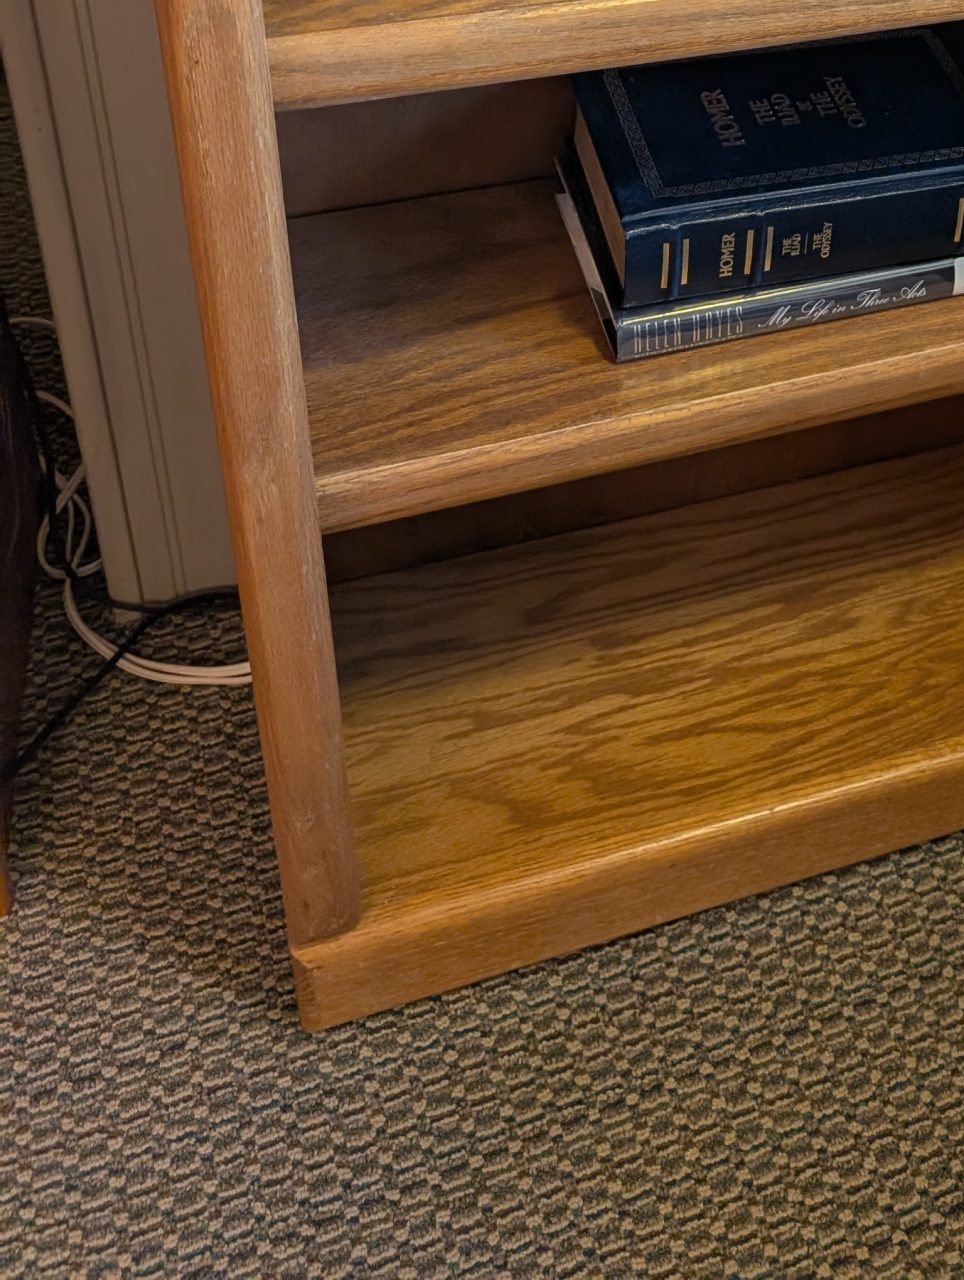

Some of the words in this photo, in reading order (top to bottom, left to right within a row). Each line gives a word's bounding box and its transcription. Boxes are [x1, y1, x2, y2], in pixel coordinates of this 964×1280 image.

[701, 89, 745, 148] HOMER
[750, 98, 776, 127] THE
[771, 93, 800, 127] ILIAD
[810, 91, 837, 117] THE
[822, 76, 866, 129] ODYSSEY
[719, 232, 736, 278] HOMER
[782, 237, 793, 256] THE
[790, 233, 801, 257] ILIAD
[812, 232, 823, 250] THE
[820, 222, 833, 259] ODYSSEY
[758, 305, 792, 328] My
[796, 299, 831, 320] Life
[832, 304, 847, 314] in
[850, 288, 889, 310] Three
[892, 279, 927, 301] Acts
[633, 317, 681, 354] HELEN
[692, 306, 743, 343] HAYES
